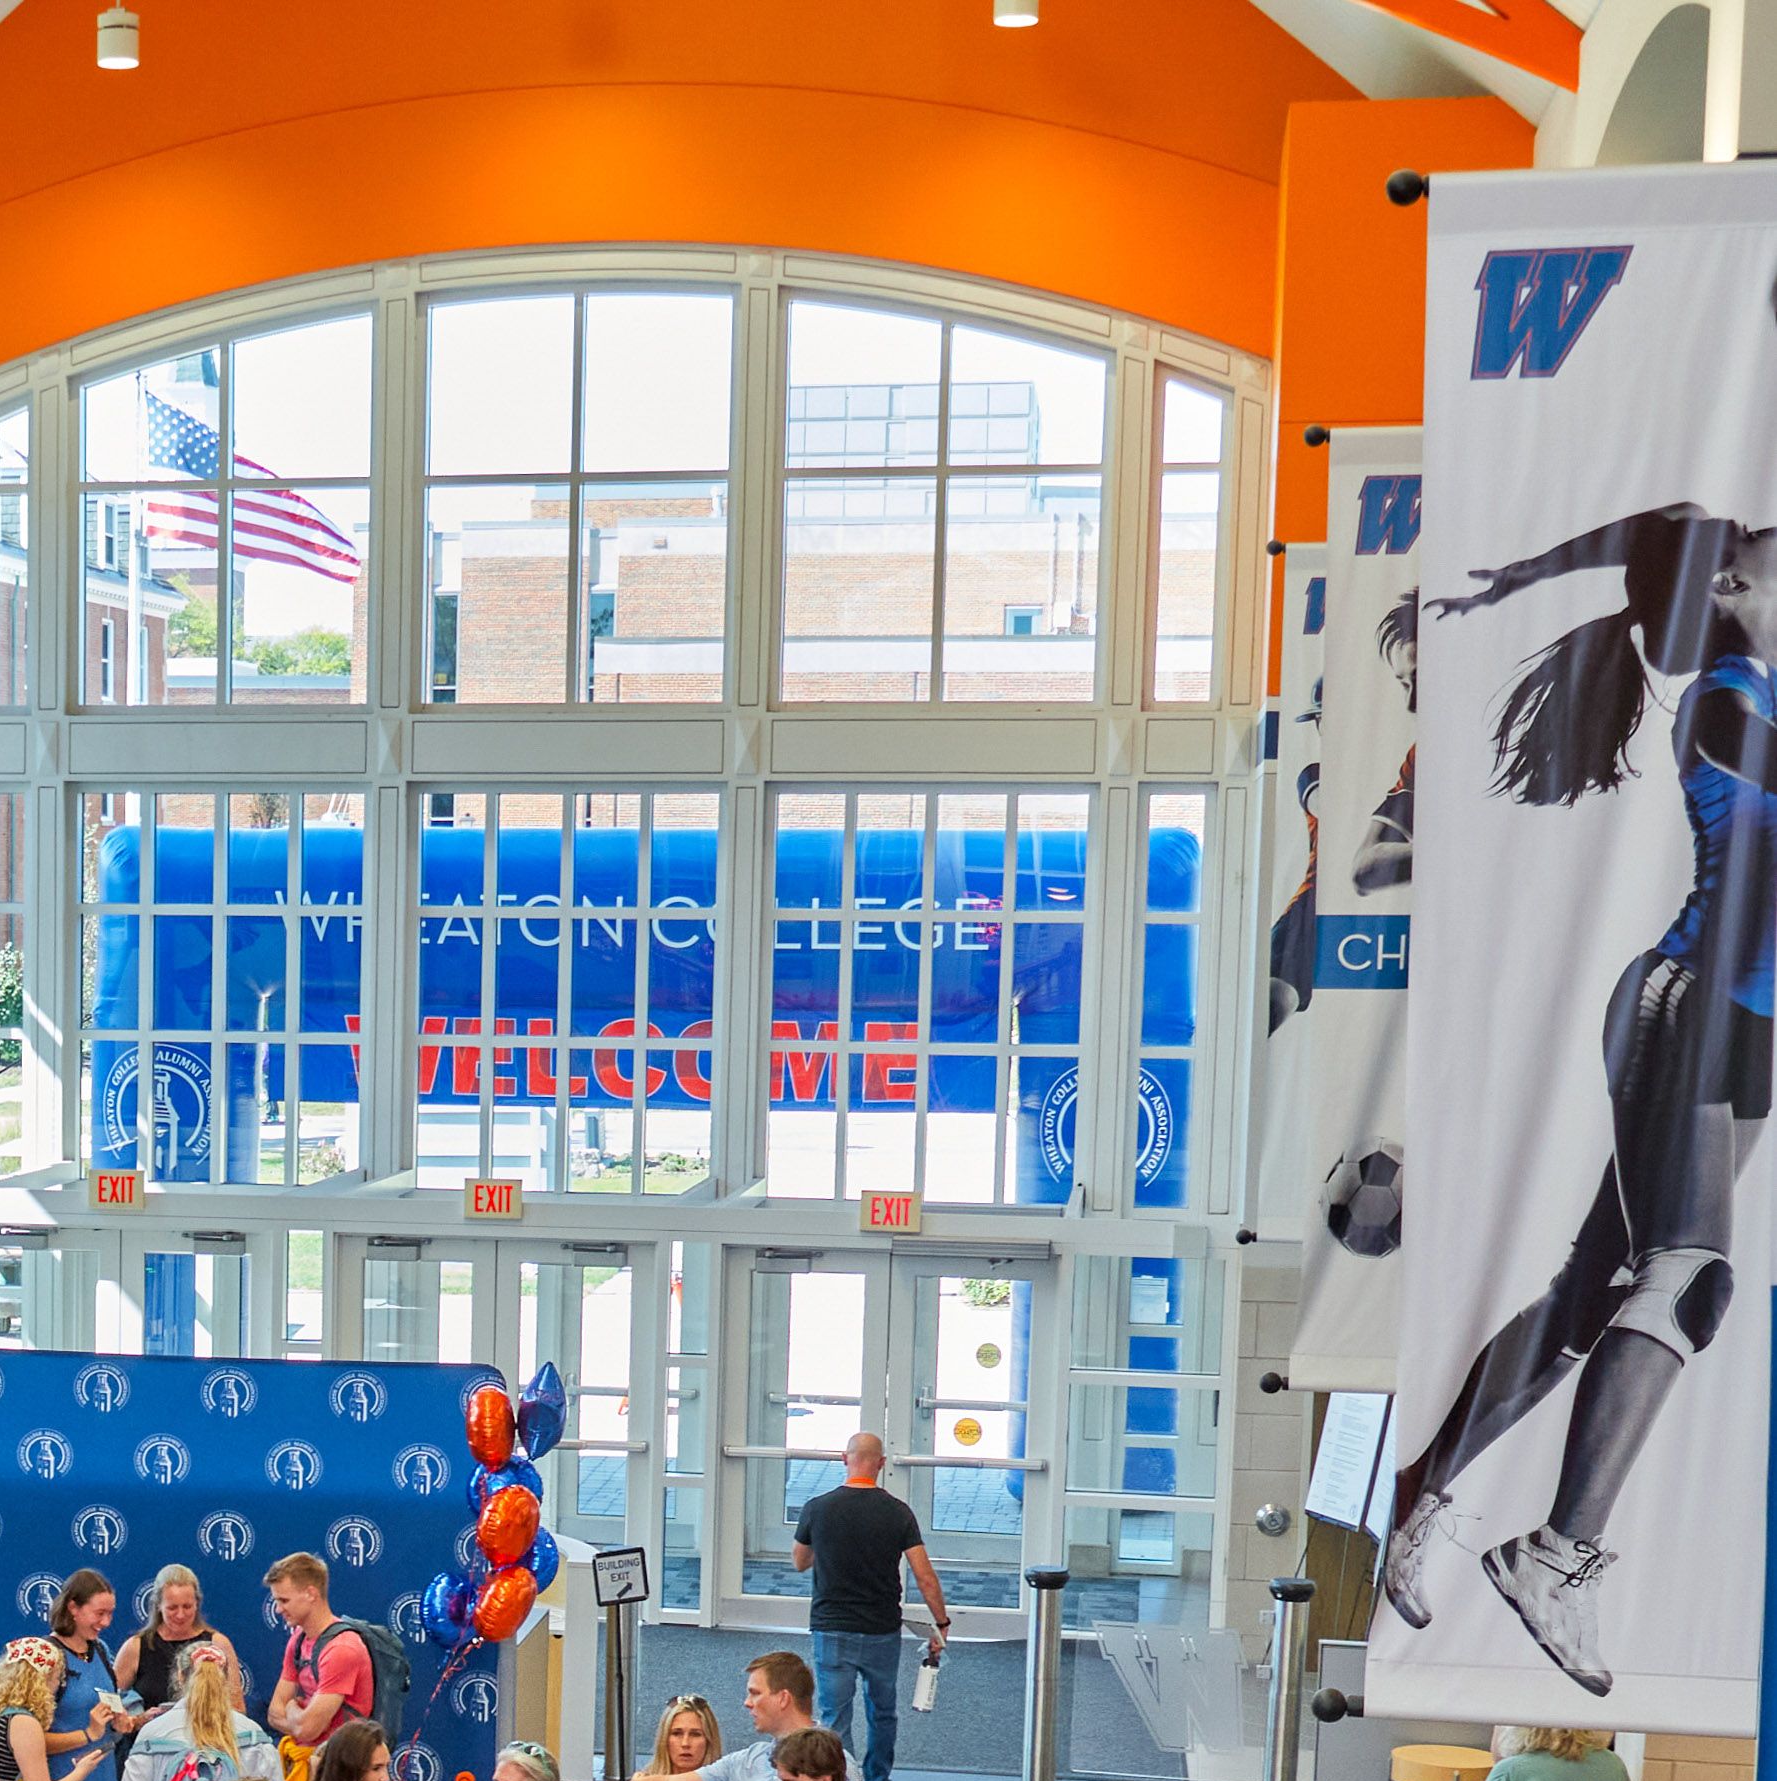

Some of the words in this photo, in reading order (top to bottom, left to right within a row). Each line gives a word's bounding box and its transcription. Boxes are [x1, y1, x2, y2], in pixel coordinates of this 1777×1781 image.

[1470, 245, 1633, 381] W
[275, 890, 625, 948] WHATON
[651, 896, 990, 951] CLLEGE
[112, 1053, 139, 1086] COLLE
[155, 1050, 203, 1077] ALUMNI
[1051, 1075, 1078, 1106] COLL
[1044, 1107, 1065, 1175] WHEATON
[1139, 1095, 1168, 1178] ASSOCIATION
[98, 1176, 137, 1204] EXIT
[475, 1184, 515, 1214] EXIT
[871, 1197, 913, 1227] EXIT
[597, 1557, 640, 1571] BUILDING
[610, 1571, 630, 1582] EXIT
